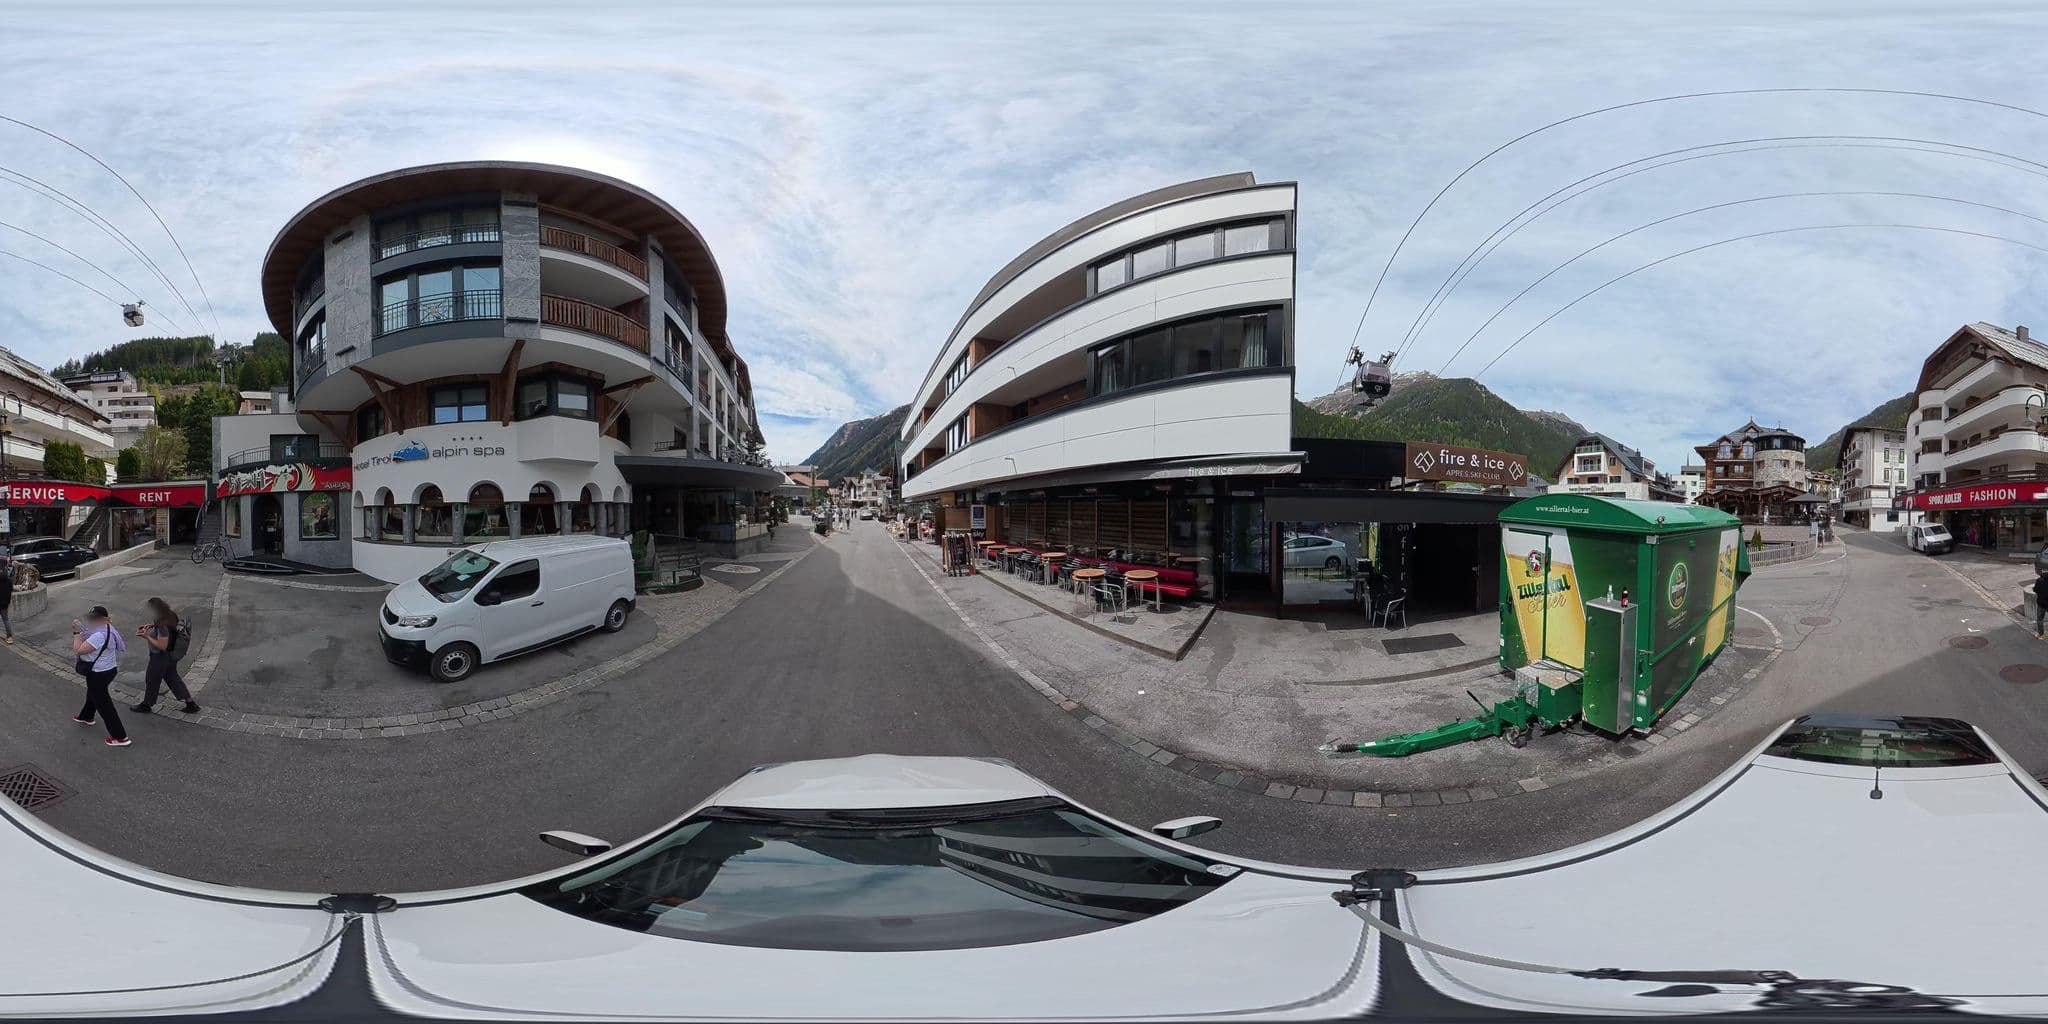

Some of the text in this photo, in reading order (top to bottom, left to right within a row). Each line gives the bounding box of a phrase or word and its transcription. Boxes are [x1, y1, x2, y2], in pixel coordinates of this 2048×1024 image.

[354, 446, 505, 472] Hotel Tirol alpin spa
[1440, 449, 1505, 470] fire & ice
[139, 492, 171, 502] RENT
[1929, 488, 2017, 505] SPORT ADLER FASHION
